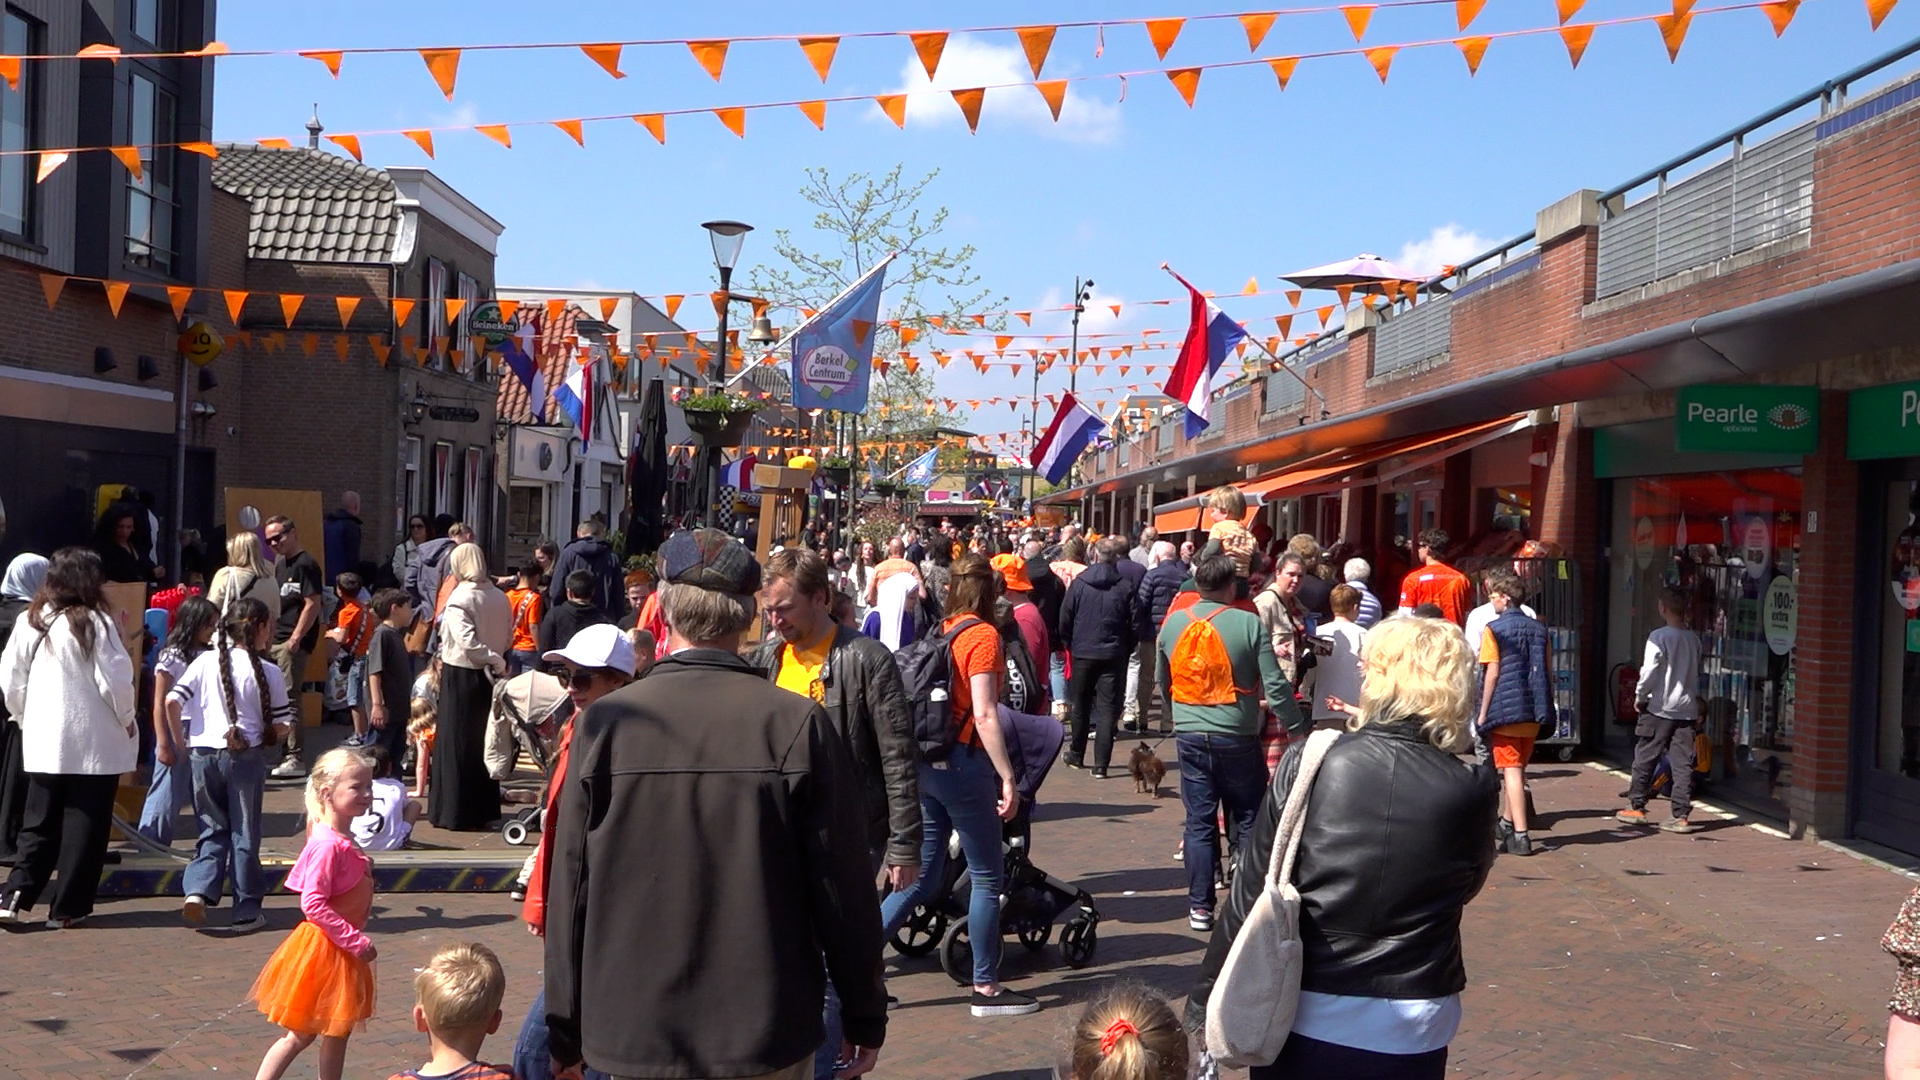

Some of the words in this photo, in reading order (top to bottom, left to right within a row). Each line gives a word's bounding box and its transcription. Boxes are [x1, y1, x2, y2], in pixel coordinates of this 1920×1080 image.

[472, 319, 515, 331] Heineken
[814, 352, 844, 366] Berkel
[809, 364, 846, 380] Centrum
[1687, 402, 1758, 423] Pearle
[1901, 390, 1920, 427] P
[1006, 658, 1024, 711] didas
